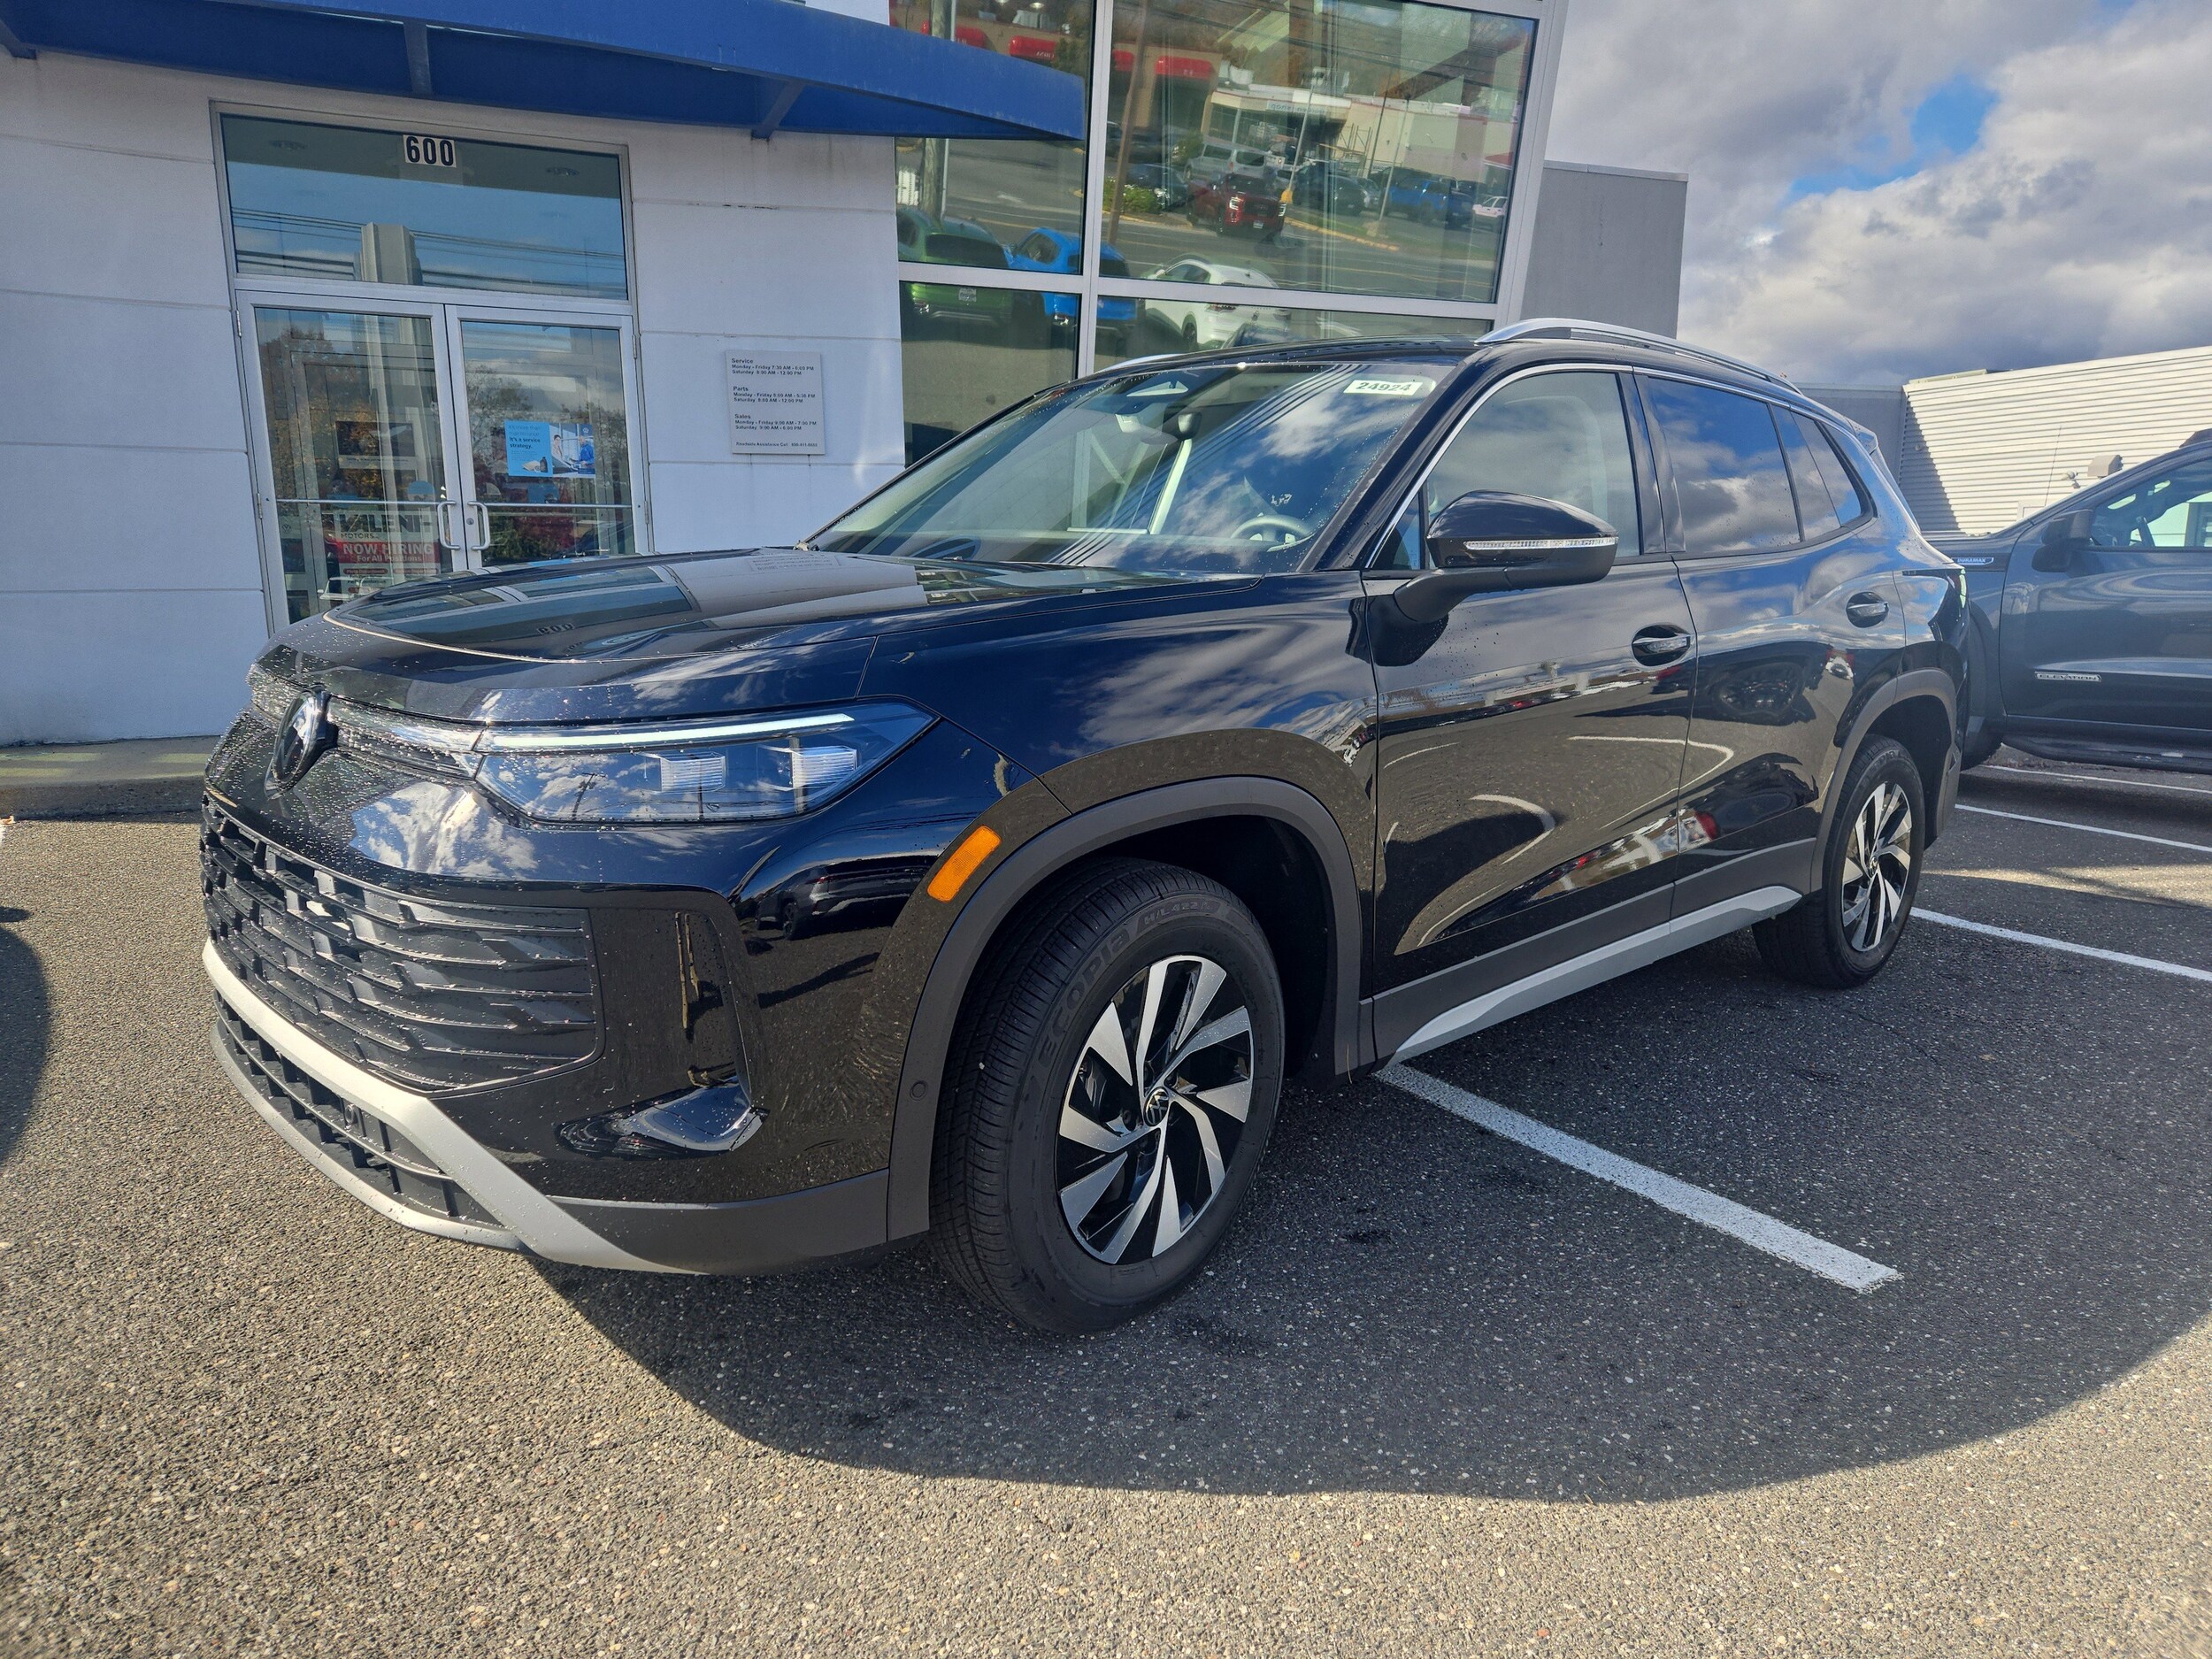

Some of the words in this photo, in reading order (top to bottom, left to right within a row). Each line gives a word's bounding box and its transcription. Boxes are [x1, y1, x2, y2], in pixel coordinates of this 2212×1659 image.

[406, 136, 454, 166] 600
[1356, 382, 1410, 392] 24924
[342, 543, 378, 555] NOW
[381, 543, 434, 555] HIRING
